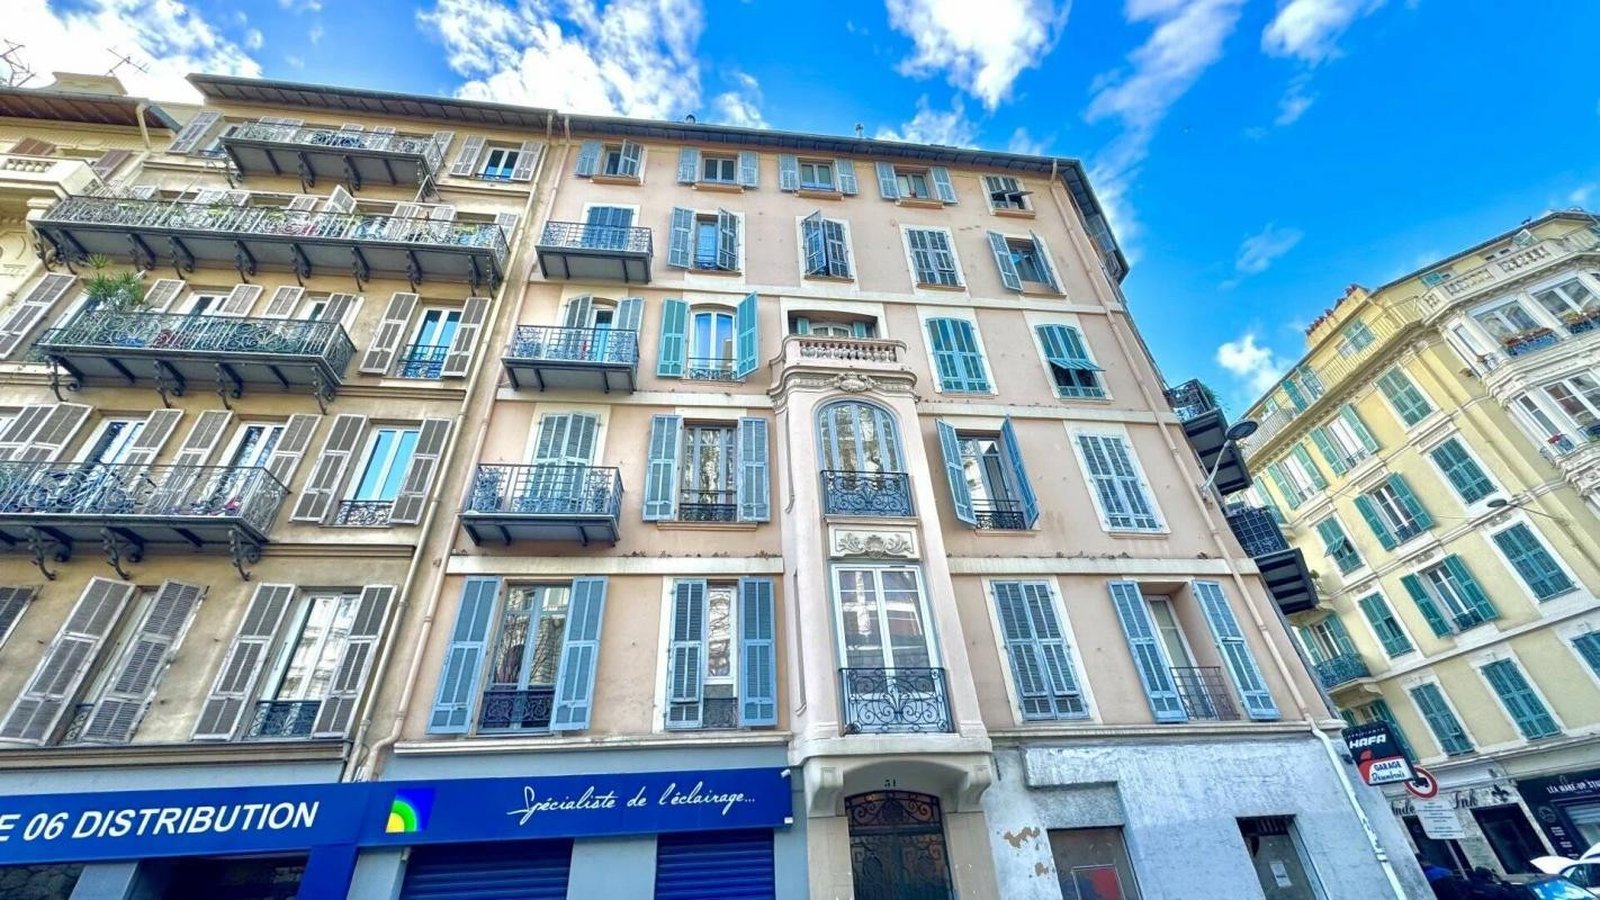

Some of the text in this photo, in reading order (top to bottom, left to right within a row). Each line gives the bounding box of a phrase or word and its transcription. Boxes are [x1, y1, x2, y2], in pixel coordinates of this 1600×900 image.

[1349, 733, 1387, 749] HAFA
[23, 811, 69, 841] 06
[71, 801, 320, 839] DISTRIBUTION
[506, 785, 619, 826] Spécialiste
[626, 785, 647, 807] de
